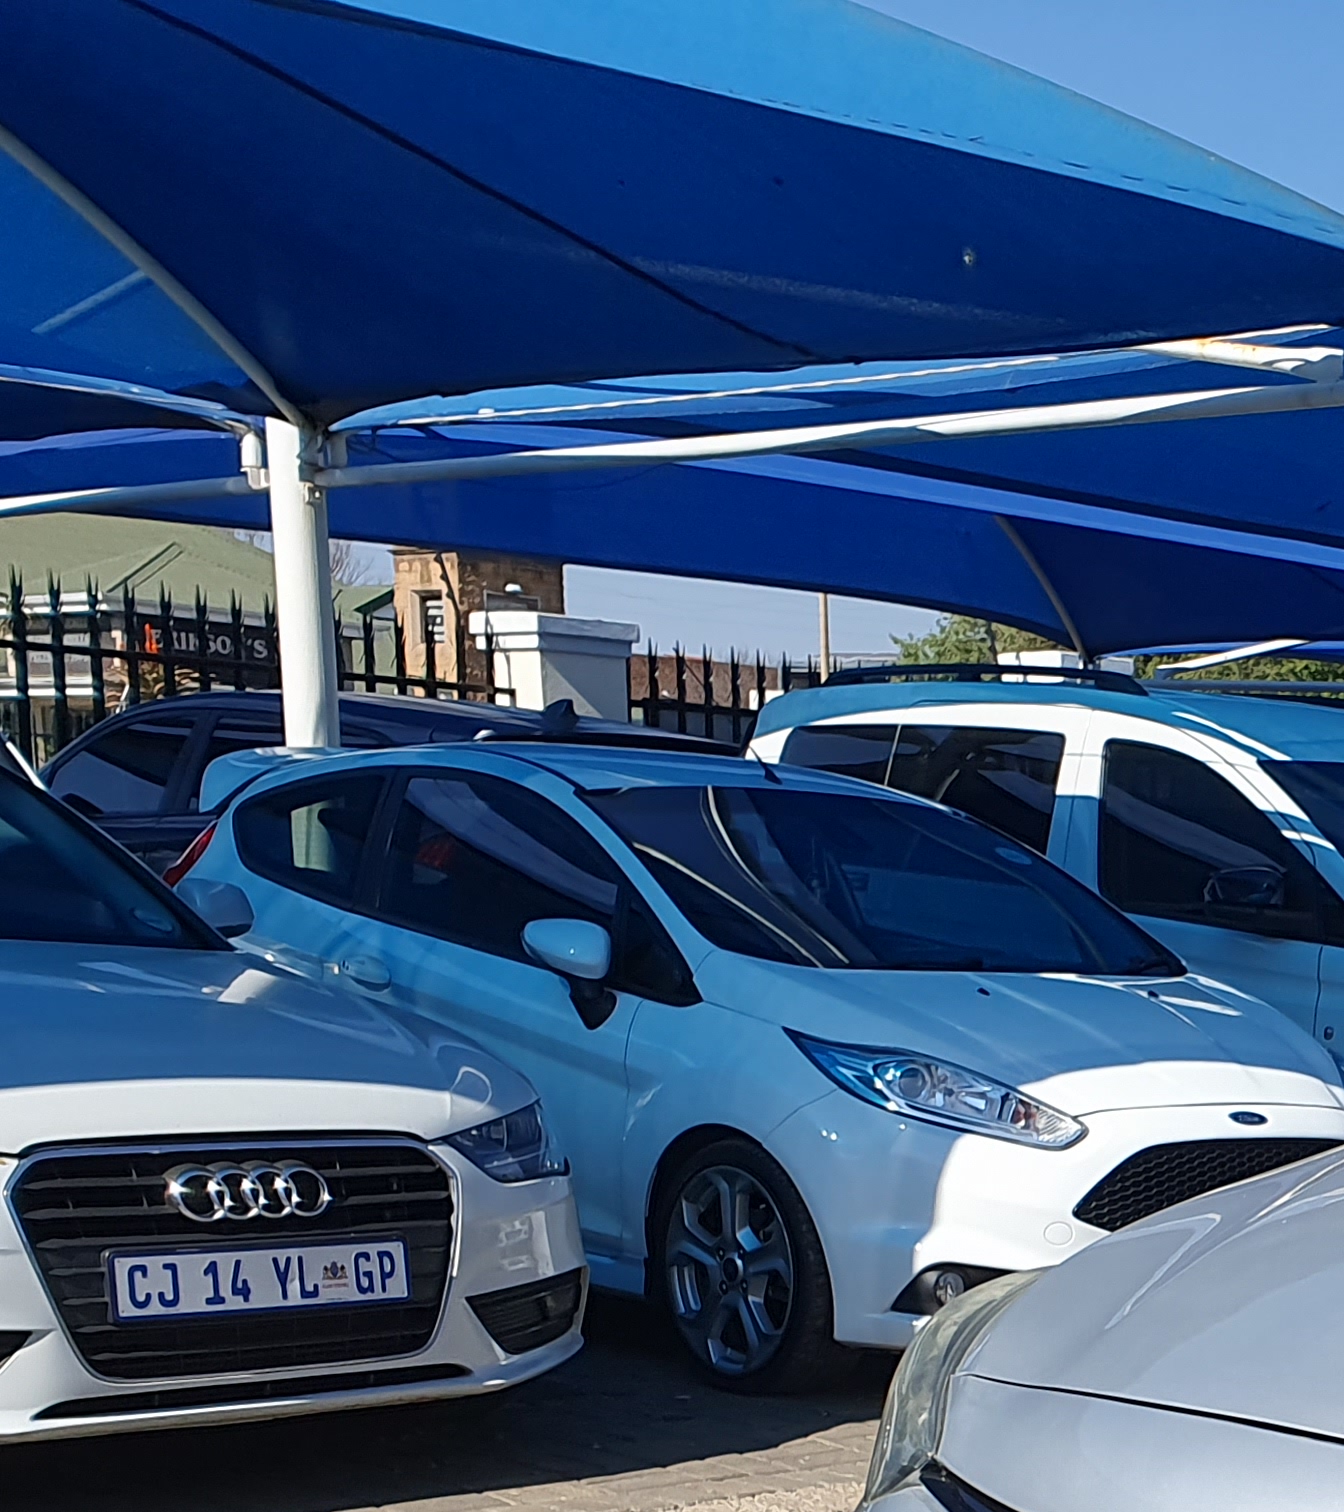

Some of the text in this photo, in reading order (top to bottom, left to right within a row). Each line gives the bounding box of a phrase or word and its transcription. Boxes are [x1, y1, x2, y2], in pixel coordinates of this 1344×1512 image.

[127, 1250, 396, 1310] CJ 14 YL GP
